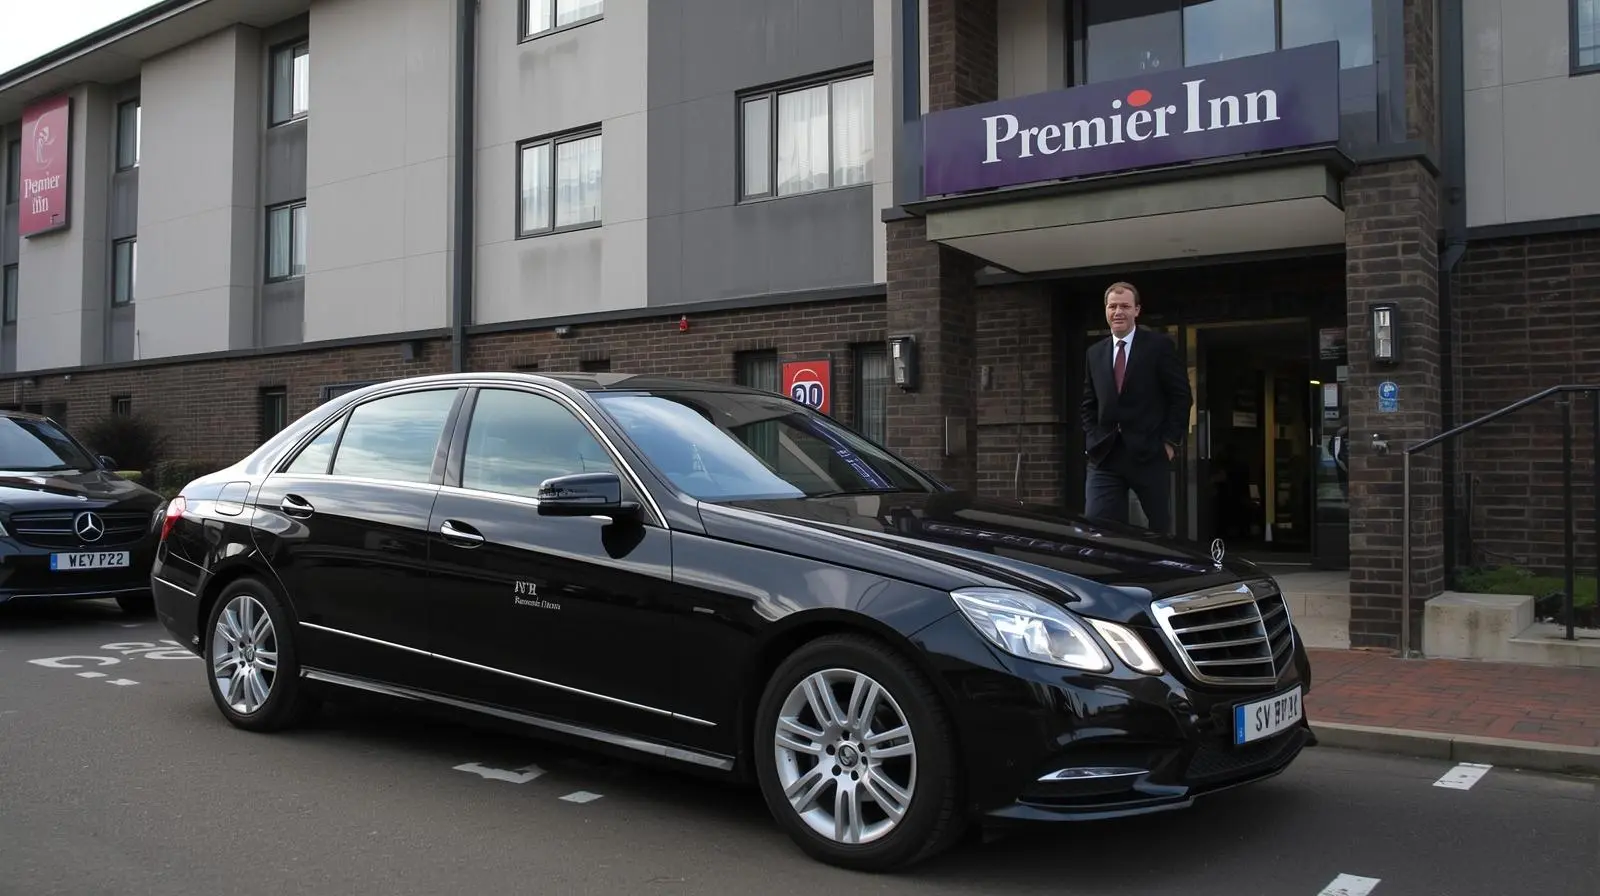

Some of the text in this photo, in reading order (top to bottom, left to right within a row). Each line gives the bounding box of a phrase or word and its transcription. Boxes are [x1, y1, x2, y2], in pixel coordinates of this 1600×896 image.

[981, 78, 1281, 164] Premier Inn
[69, 552, 124, 568] WEY P22
[1255, 703, 1271, 732] SV
